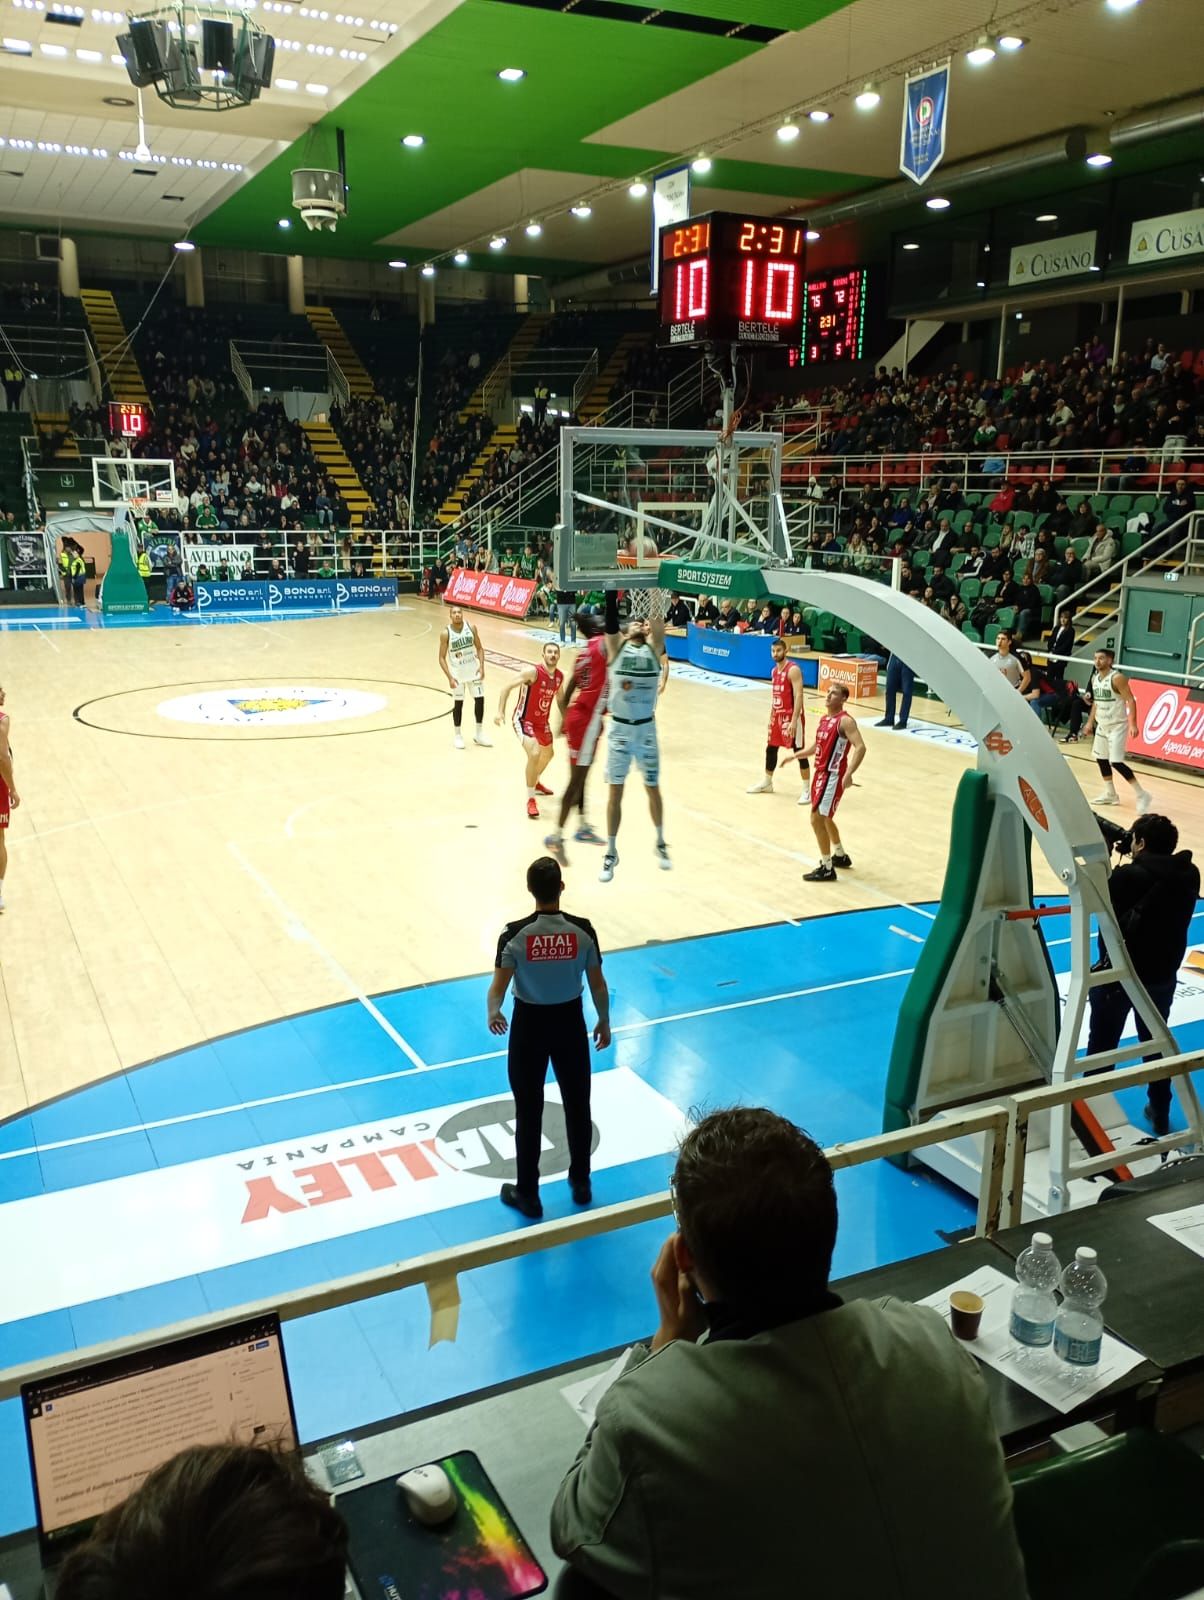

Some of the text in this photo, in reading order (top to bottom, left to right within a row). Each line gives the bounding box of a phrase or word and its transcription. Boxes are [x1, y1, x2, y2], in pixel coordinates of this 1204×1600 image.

[673, 223, 710, 257] 2:31
[740, 223, 801, 254] 2:31
[1030, 251, 1092, 277] CUSANO
[676, 259, 708, 319] 10
[744, 259, 795, 319] 10
[811, 290, 845, 308] 75 72
[811, 346, 817, 359] 3
[835, 342, 842, 356] 5
[122, 414, 142, 431] 10
[213, 588, 247, 597] BONO
[284, 587, 316, 595] BONO
[351, 584, 381, 593] BONO
[829, 667, 857, 682] DURING
[1161, 738, 1191, 755] Agenzia
[532, 935, 573, 948] ATTAL
[531, 947, 573, 957] GROUP
[236, 1122, 431, 1171] CAMPANIA
